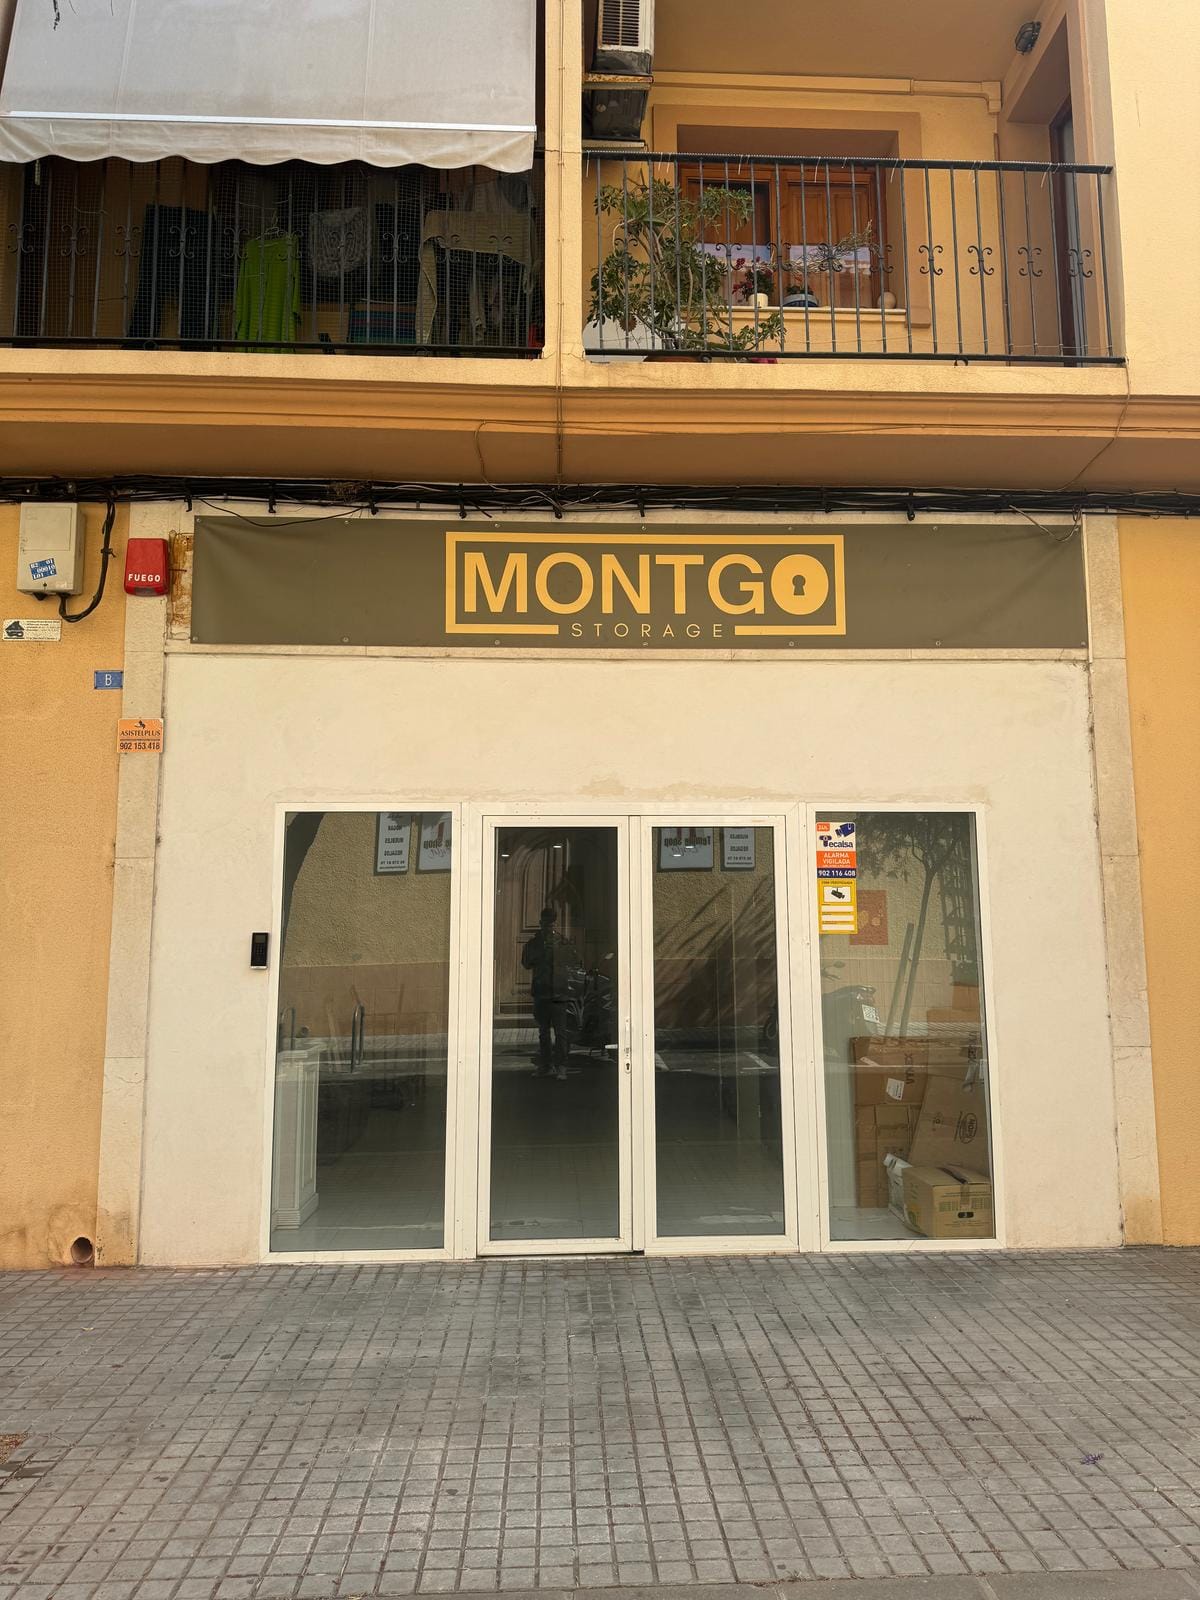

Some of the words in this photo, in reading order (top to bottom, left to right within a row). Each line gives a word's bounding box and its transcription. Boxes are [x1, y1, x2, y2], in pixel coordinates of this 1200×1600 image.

[128, 573, 161, 583] FUEGO
[464, 551, 829, 615] MONTGO
[571, 623, 724, 638] STORAGE
[105, 673, 112, 686] B
[119, 742, 132, 750] 902
[134, 742, 146, 750] 153
[819, 835, 853, 847] Tecalsa
